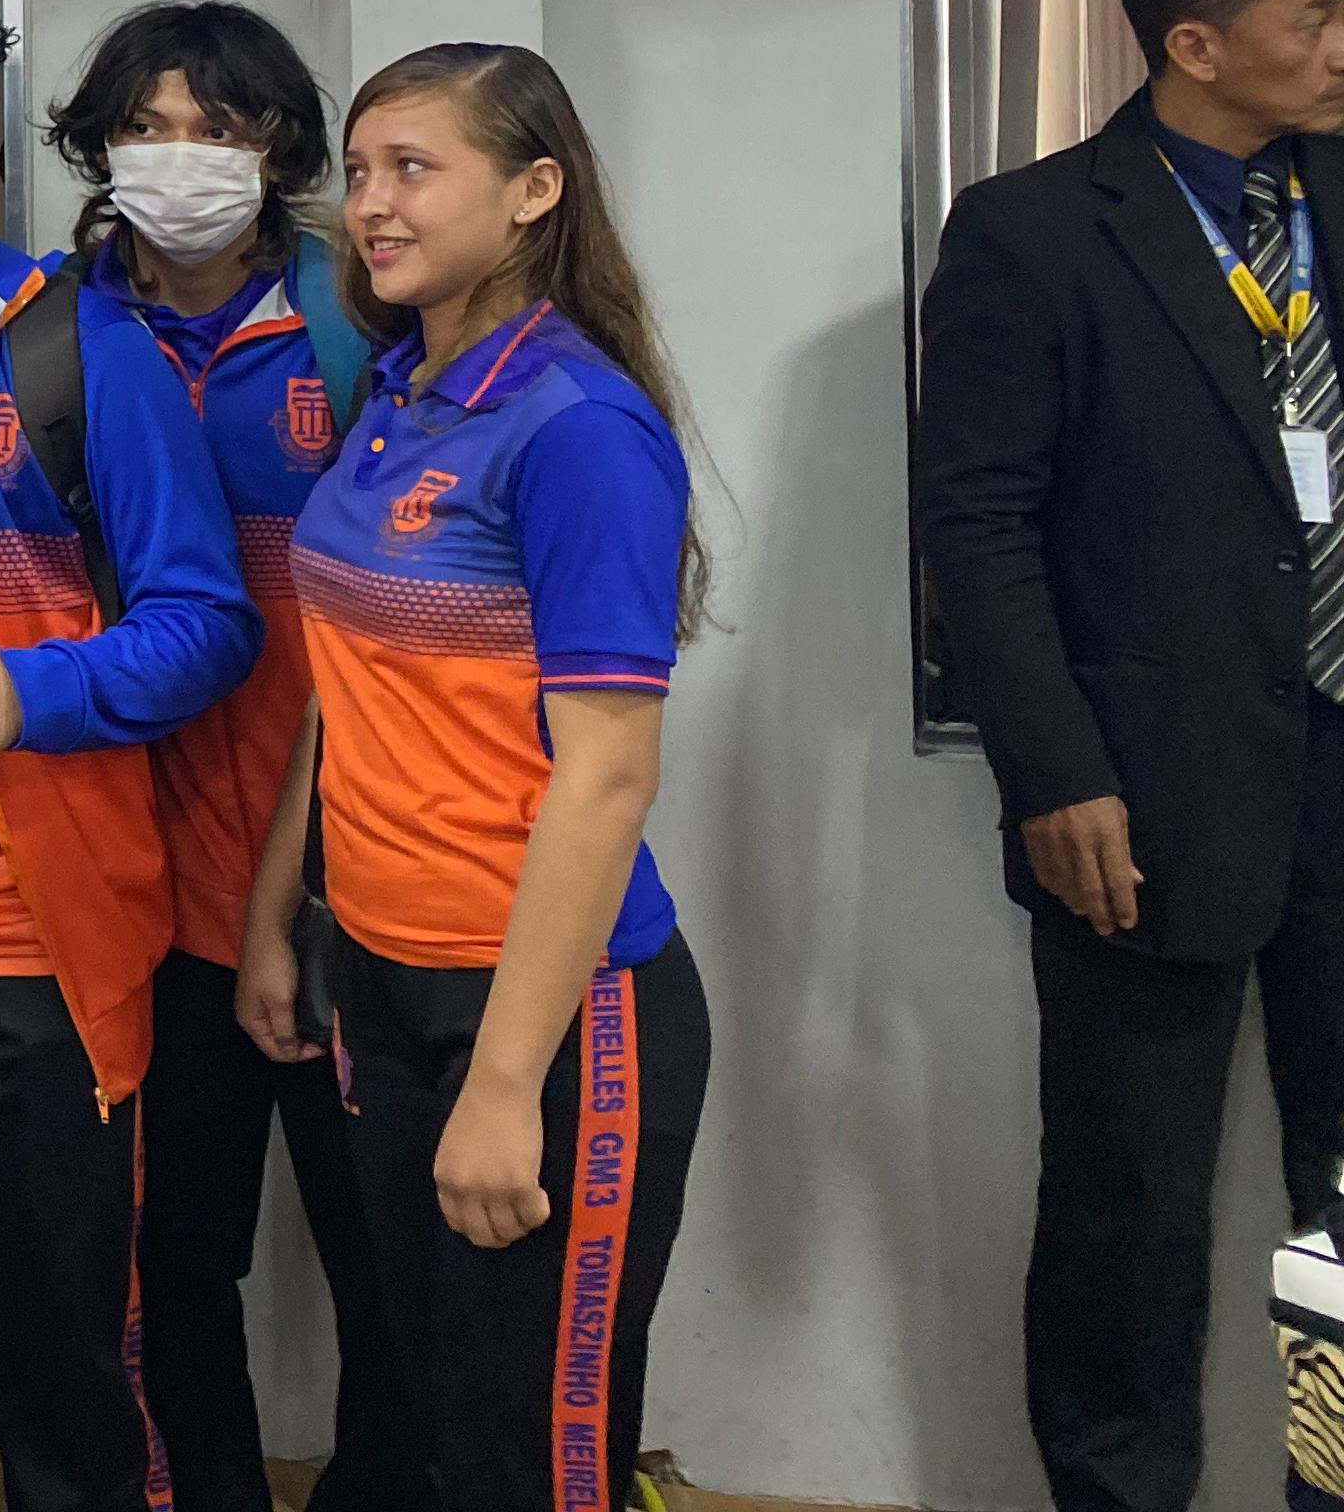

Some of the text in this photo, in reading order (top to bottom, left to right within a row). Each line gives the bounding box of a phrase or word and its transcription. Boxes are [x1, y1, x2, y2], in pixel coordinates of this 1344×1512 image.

[591, 967, 626, 1113] MEIRELLES
[585, 1132, 624, 1208] GM3
[563, 1235, 613, 1408] TOMASZINHO
